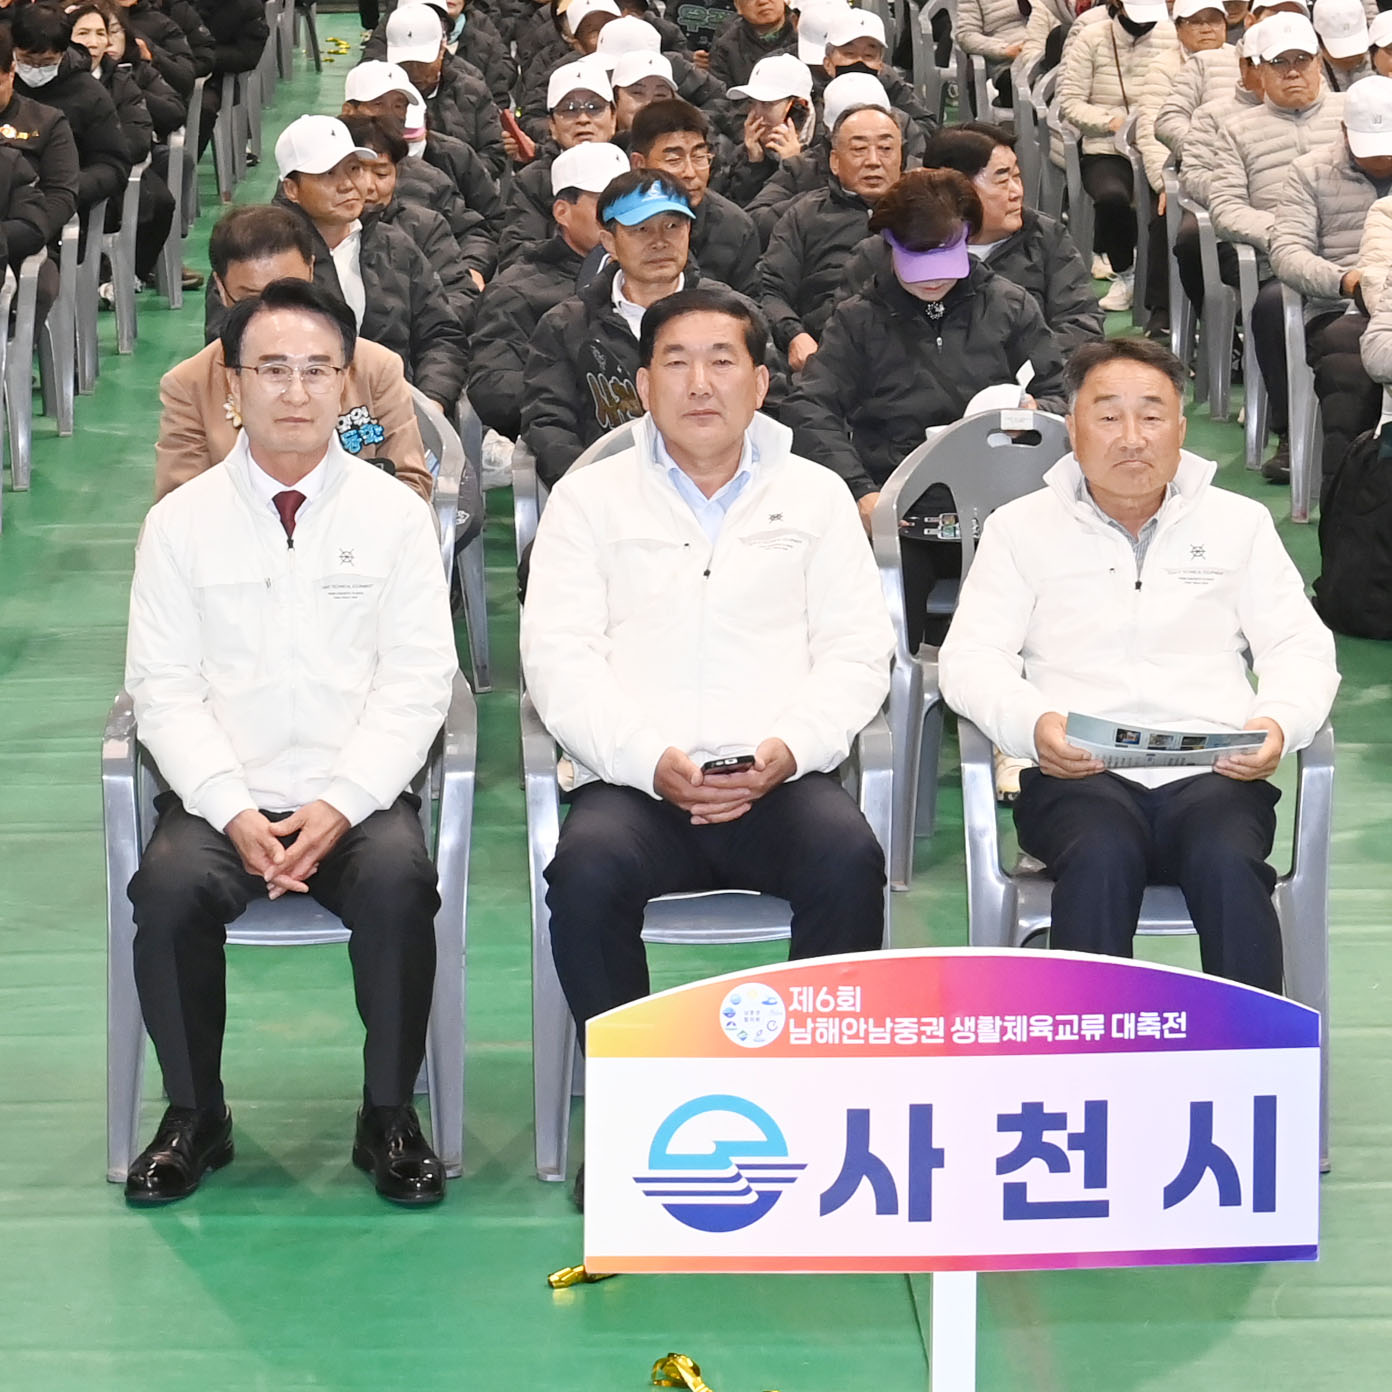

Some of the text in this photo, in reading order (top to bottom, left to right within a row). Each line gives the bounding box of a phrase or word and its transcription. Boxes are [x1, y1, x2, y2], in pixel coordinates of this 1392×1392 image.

[788, 985, 863, 1015] 제6회
[789, 1010, 1187, 1045] 남해안남중권 생활체육교류 대축전
